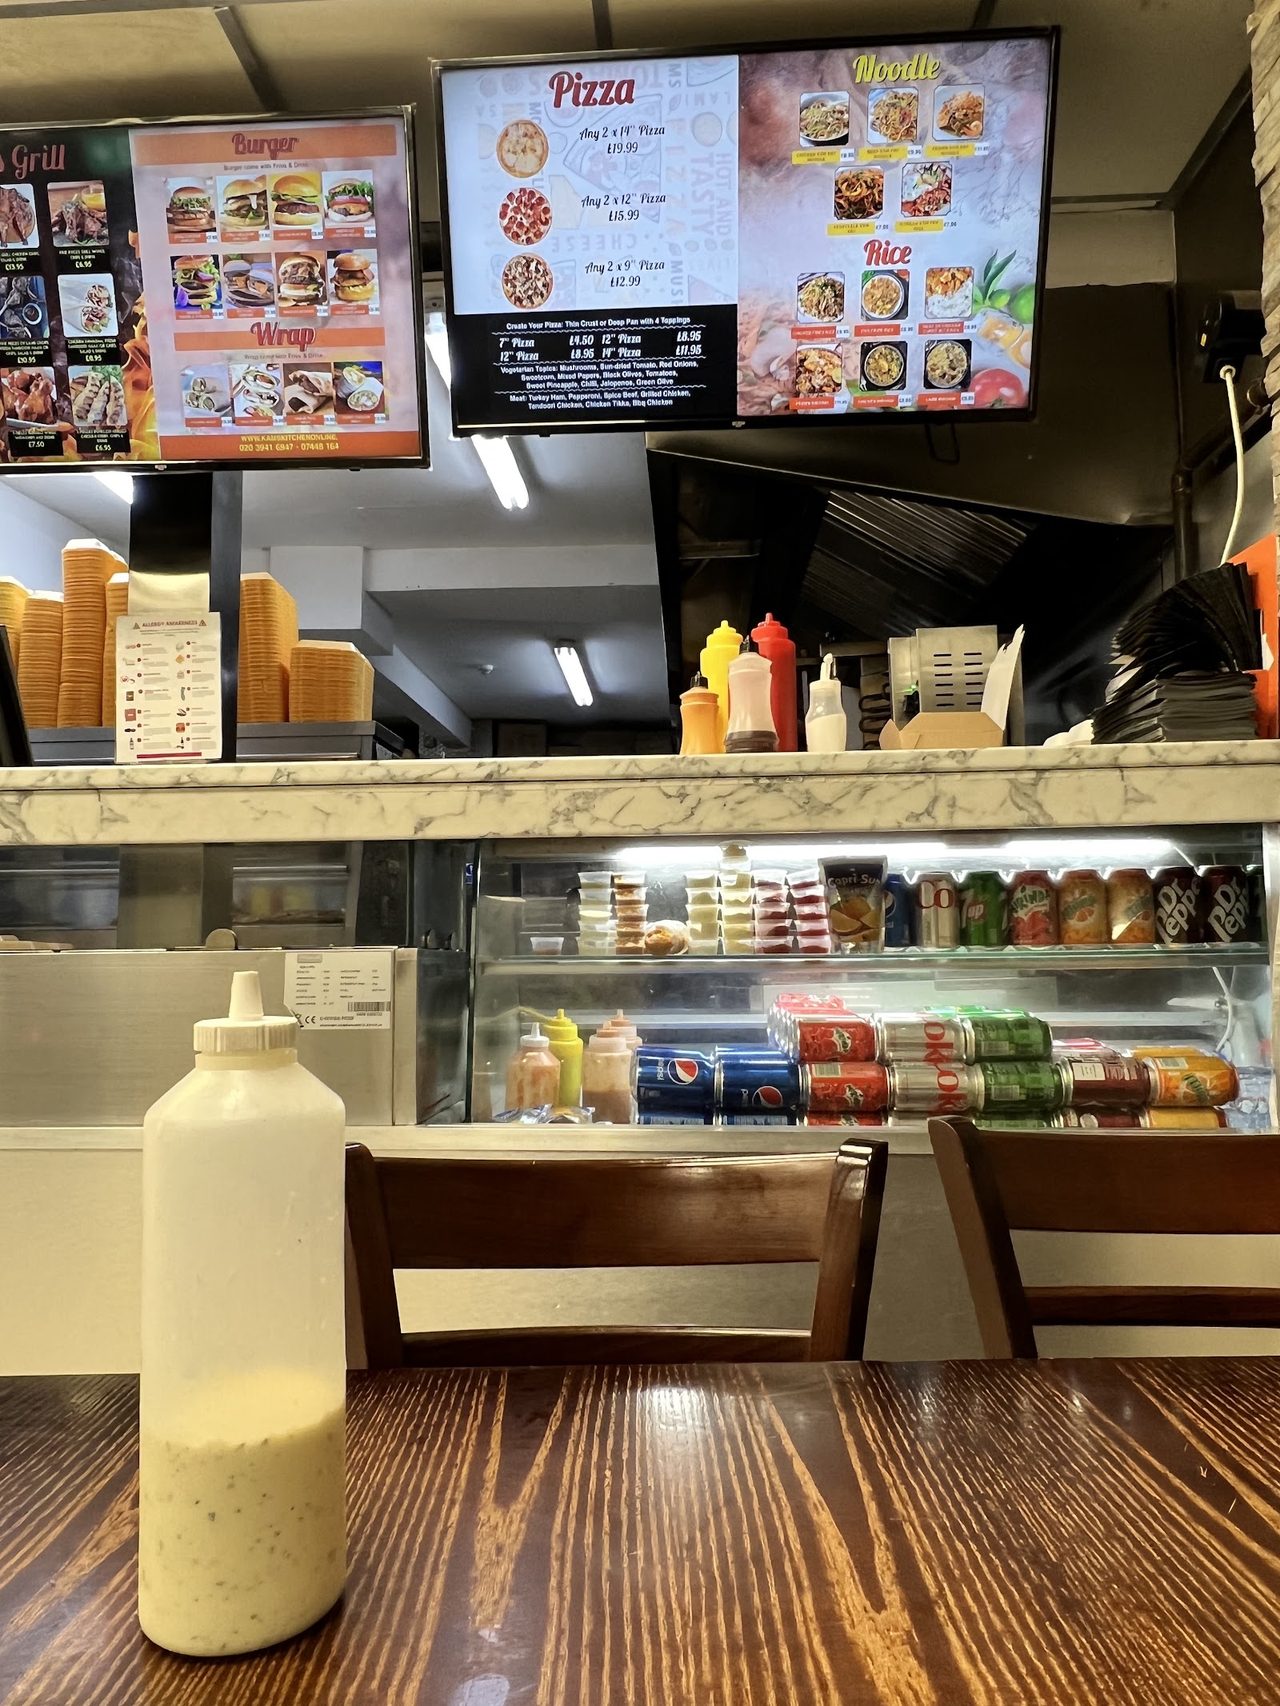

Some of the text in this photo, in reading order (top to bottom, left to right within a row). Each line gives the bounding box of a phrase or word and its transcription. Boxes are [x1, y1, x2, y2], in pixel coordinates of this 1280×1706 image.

[853, 52, 941, 83] Noodle
[548, 71, 635, 108] Pizza
[579, 128, 600, 141] Any
[602, 126, 609, 138] 2
[612, 129, 618, 137] x
[638, 125, 665, 136] Pizza
[232, 133, 299, 160] Burger
[607, 142, 639, 154] £19.99
[12, 144, 65, 179] Grill
[581, 195, 601, 209] Any
[603, 195, 610, 205] 2
[613, 197, 619, 205] x
[640, 192, 666, 204] Pizza
[608, 210, 639, 221] £15.99
[864, 239, 912, 266] Rice
[584, 262, 605, 275] Any
[607, 261, 613, 271] 2
[616, 263, 622, 271] x
[638, 259, 665, 270] Pizza
[610, 276, 641, 287] £12.99
[506, 322, 528, 330] Create
[608, 319, 625, 327] Deep
[660, 316, 691, 325] Toppings
[250, 321, 315, 352] Wrap
[511, 338, 535, 348] Pizza
[569, 334, 594, 346] £4.50
[618, 334, 642, 344] Pizza
[676, 331, 702, 342] £8.95
[516, 351, 539, 361] Pizza
[571, 348, 594, 359] £8.95
[618, 347, 641, 357] Pizza
[675, 344, 702, 356] £11.95
[560, 364, 599, 372] Mushrooms,
[546, 382, 579, 391] Pineapple,
[528, 394, 550, 402] Turkey
[640, 390, 662, 398] Grilled
[239, 444, 254, 452] 020
[255, 443, 273, 451] 3941
[326, 442, 339, 450] 164
[1158, 878, 1184, 915] Dr
[1214, 877, 1241, 914] Dr
